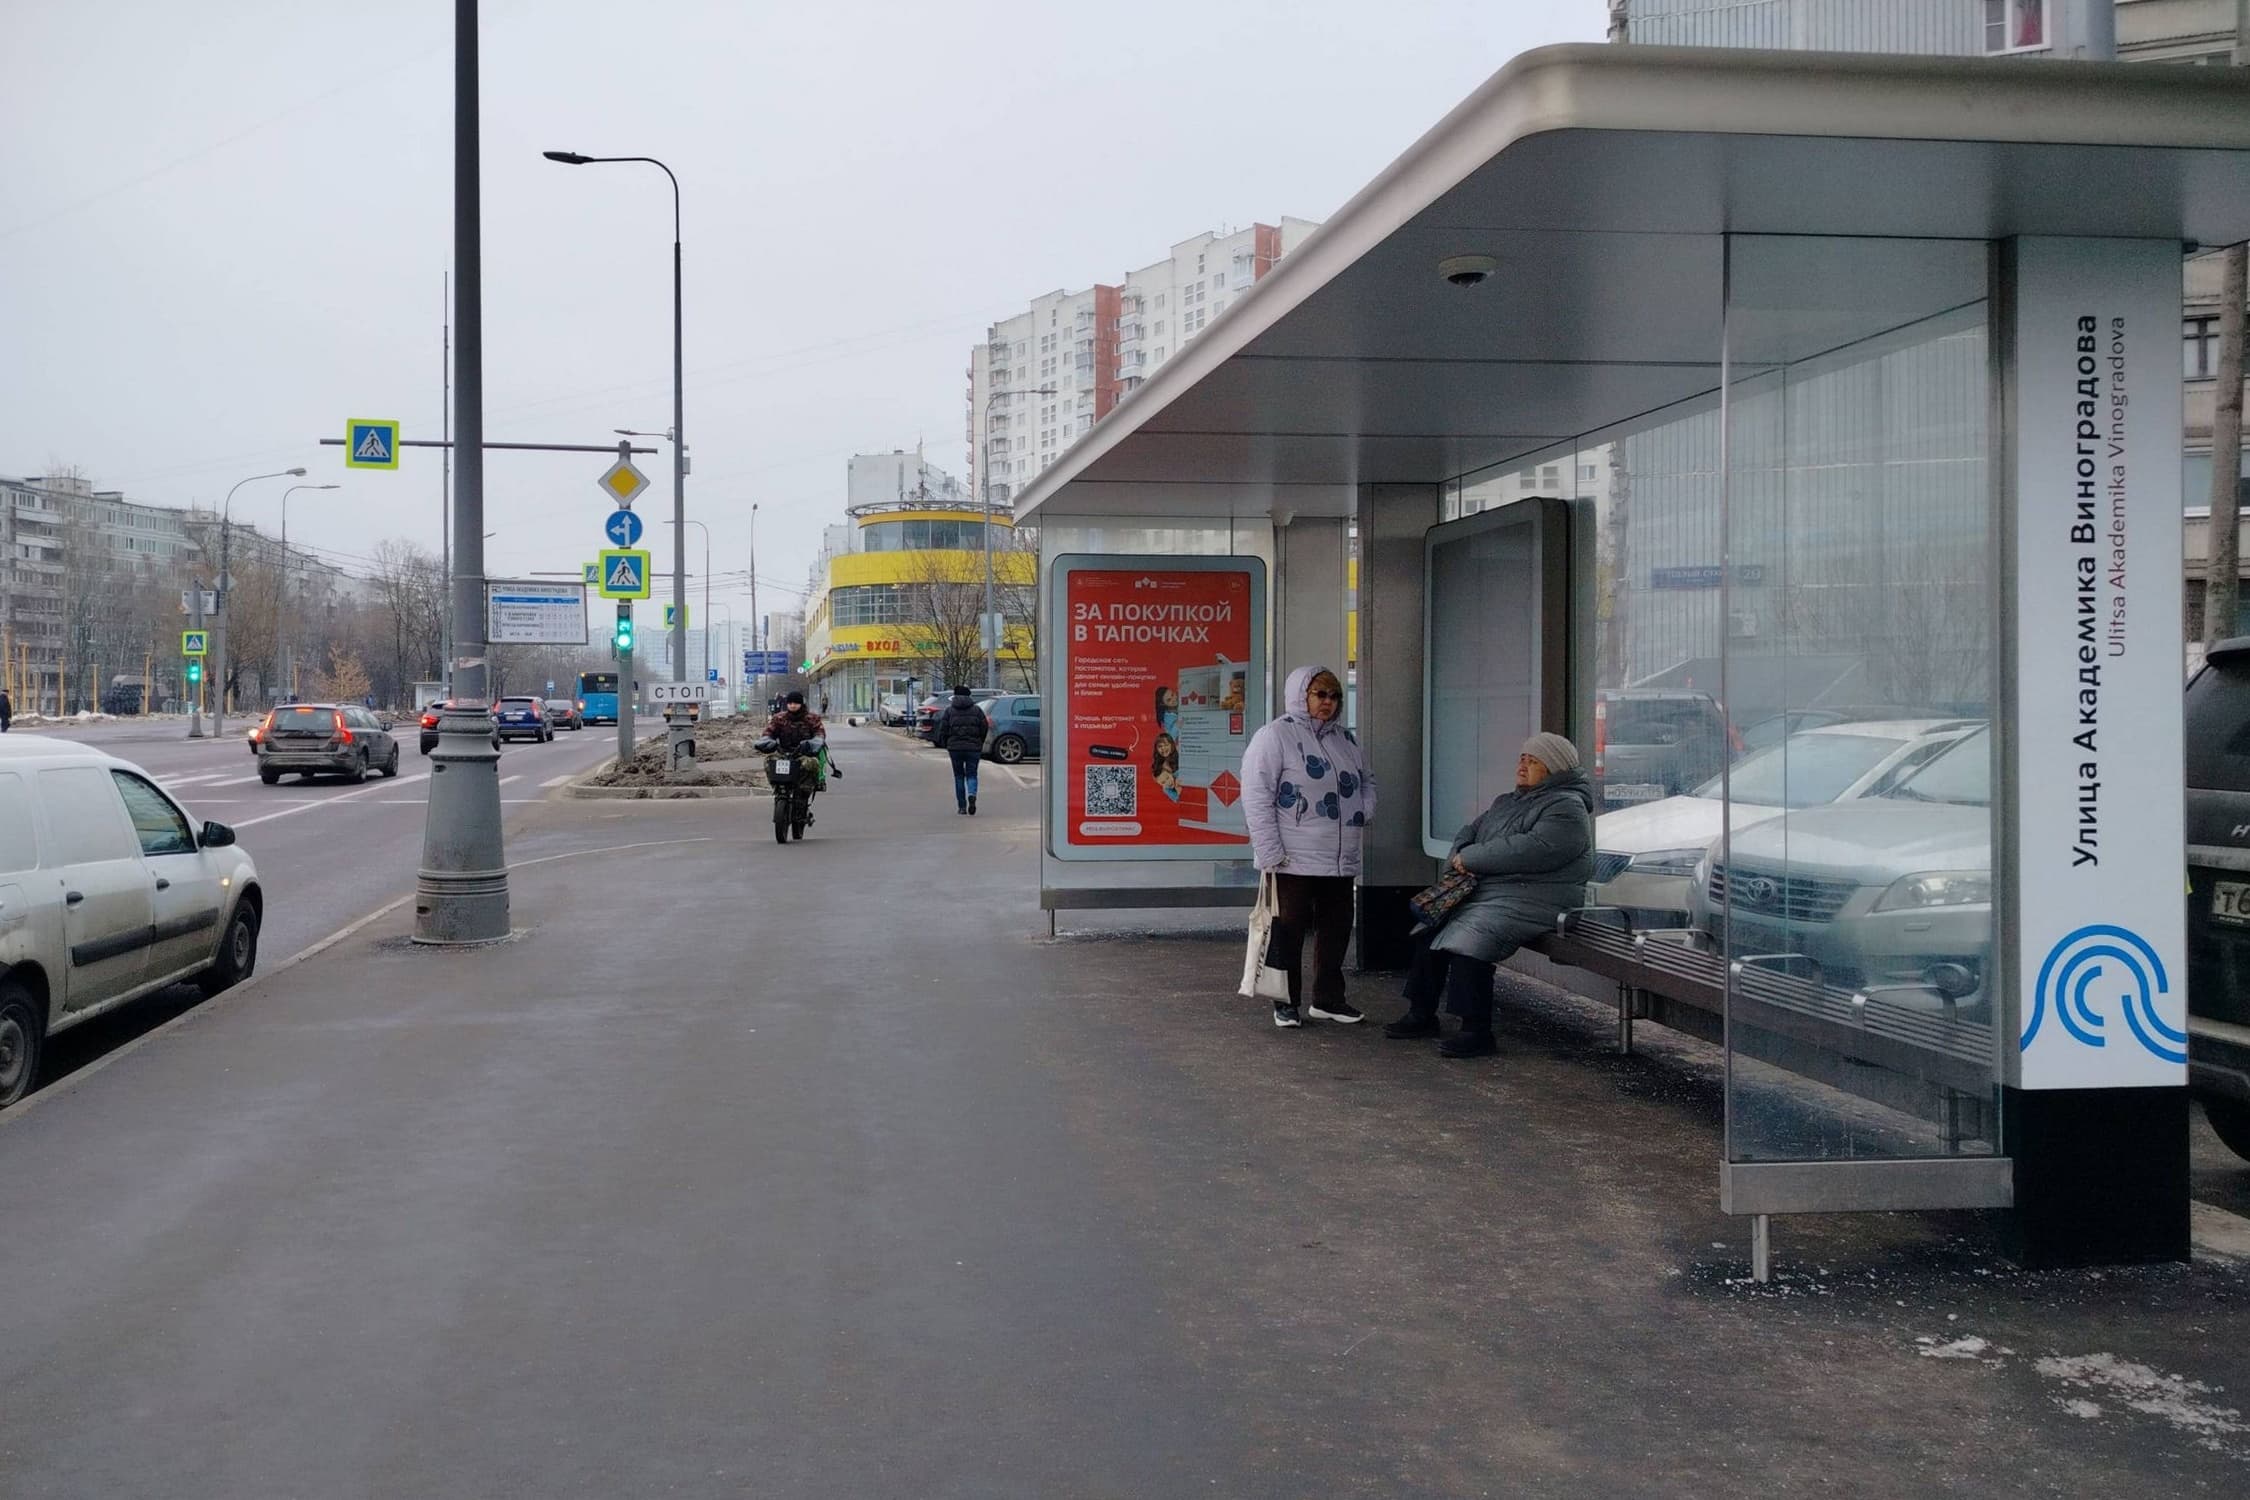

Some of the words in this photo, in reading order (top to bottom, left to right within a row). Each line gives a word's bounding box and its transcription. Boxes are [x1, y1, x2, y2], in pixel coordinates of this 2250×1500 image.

[2107, 316, 2128, 458] Vinogradova
[2070, 315, 2101, 544] Виноградова
[2107, 465, 2127, 589] Akademika
[866, 640, 900, 653] ВХОД
[1074, 603, 1102, 621] ЗА
[1109, 601, 1232, 622] ПОКУПКОЙ
[1074, 625, 1088, 641] В
[1095, 625, 1209, 643] ТАПОЧКАХ
[2108, 597, 2126, 657] Ulitsa
[654, 686, 705, 699] СТОП
[2072, 556, 2101, 752] Академика
[2072, 762, 2101, 867] Улица
